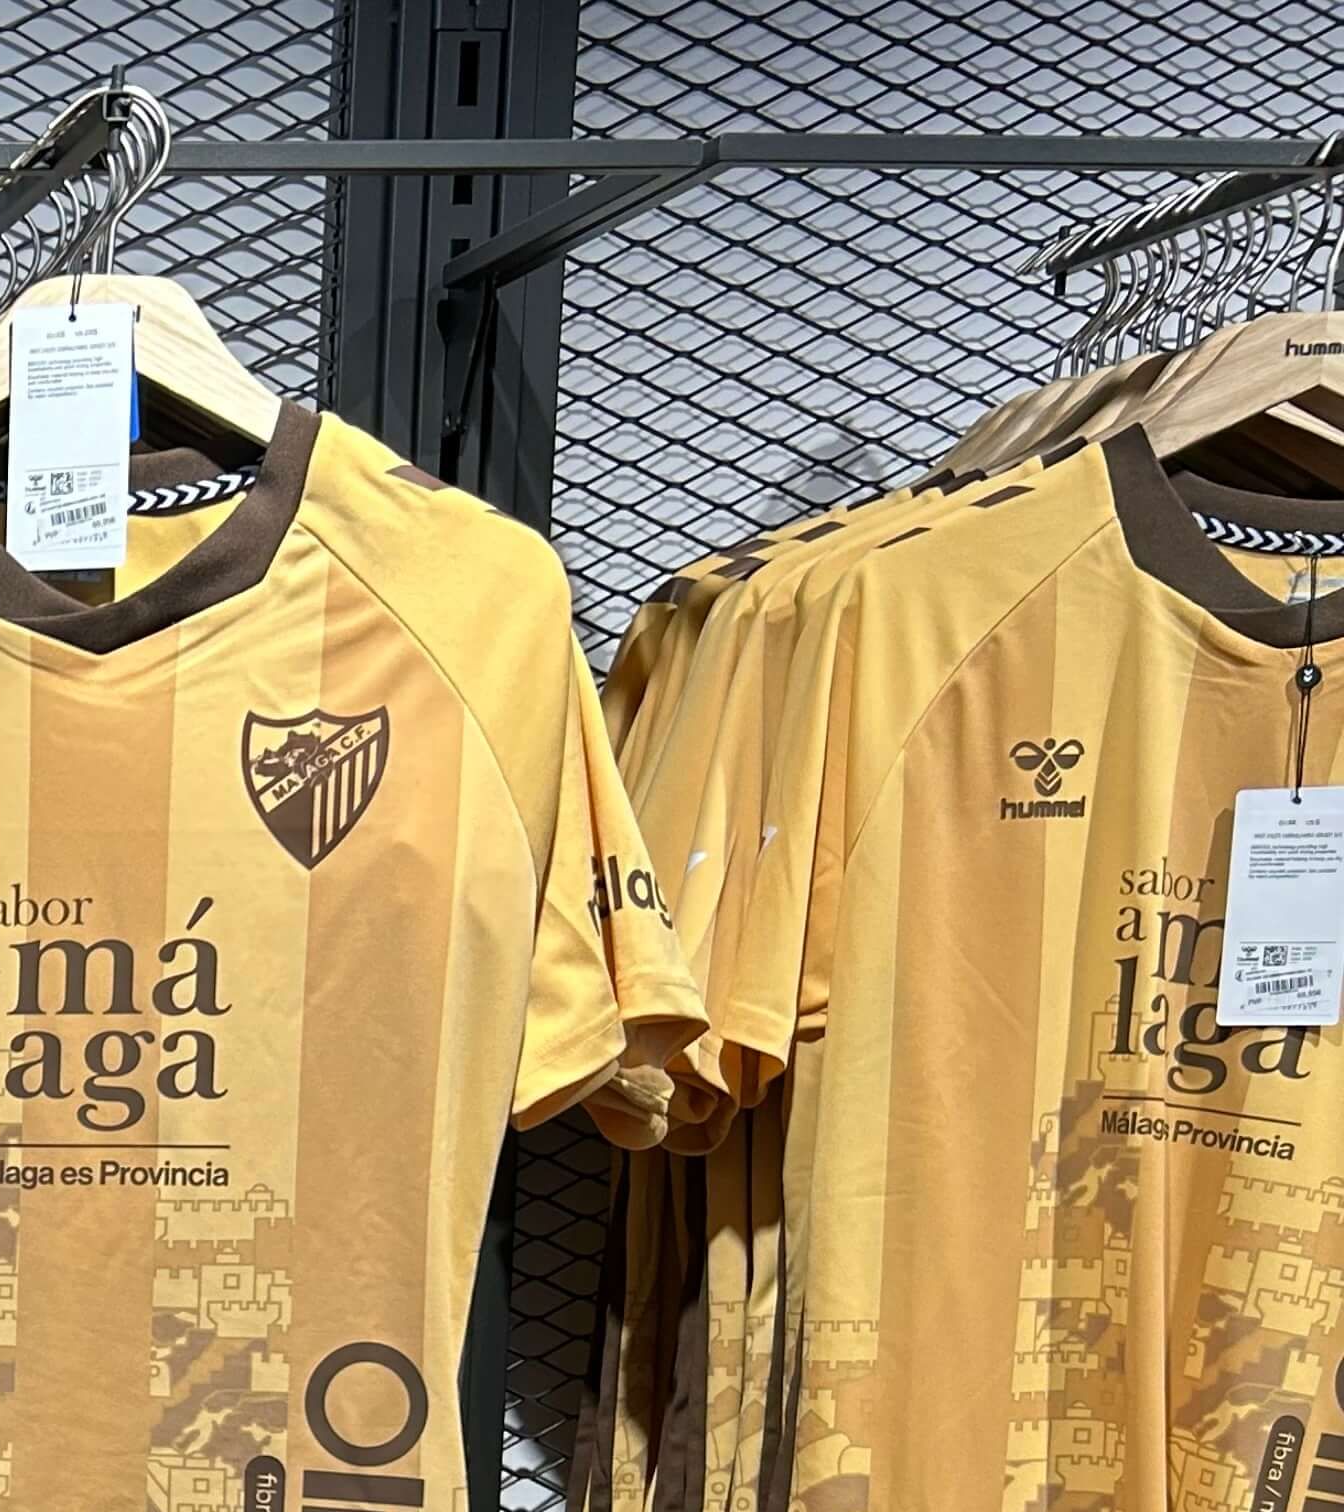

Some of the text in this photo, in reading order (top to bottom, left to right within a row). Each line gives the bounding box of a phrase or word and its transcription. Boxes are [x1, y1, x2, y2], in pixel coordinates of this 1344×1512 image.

[1000, 795, 1085, 820] hummel
[1119, 857, 1215, 902] sabor
[1116, 906, 1147, 942] a
[7, 897, 232, 1017] má
[1173, 1120, 1296, 1161] Provincia
[60, 1165, 94, 1185] es
[100, 1159, 230, 1187] Provincia
[1267, 1431, 1296, 1482] fibra
